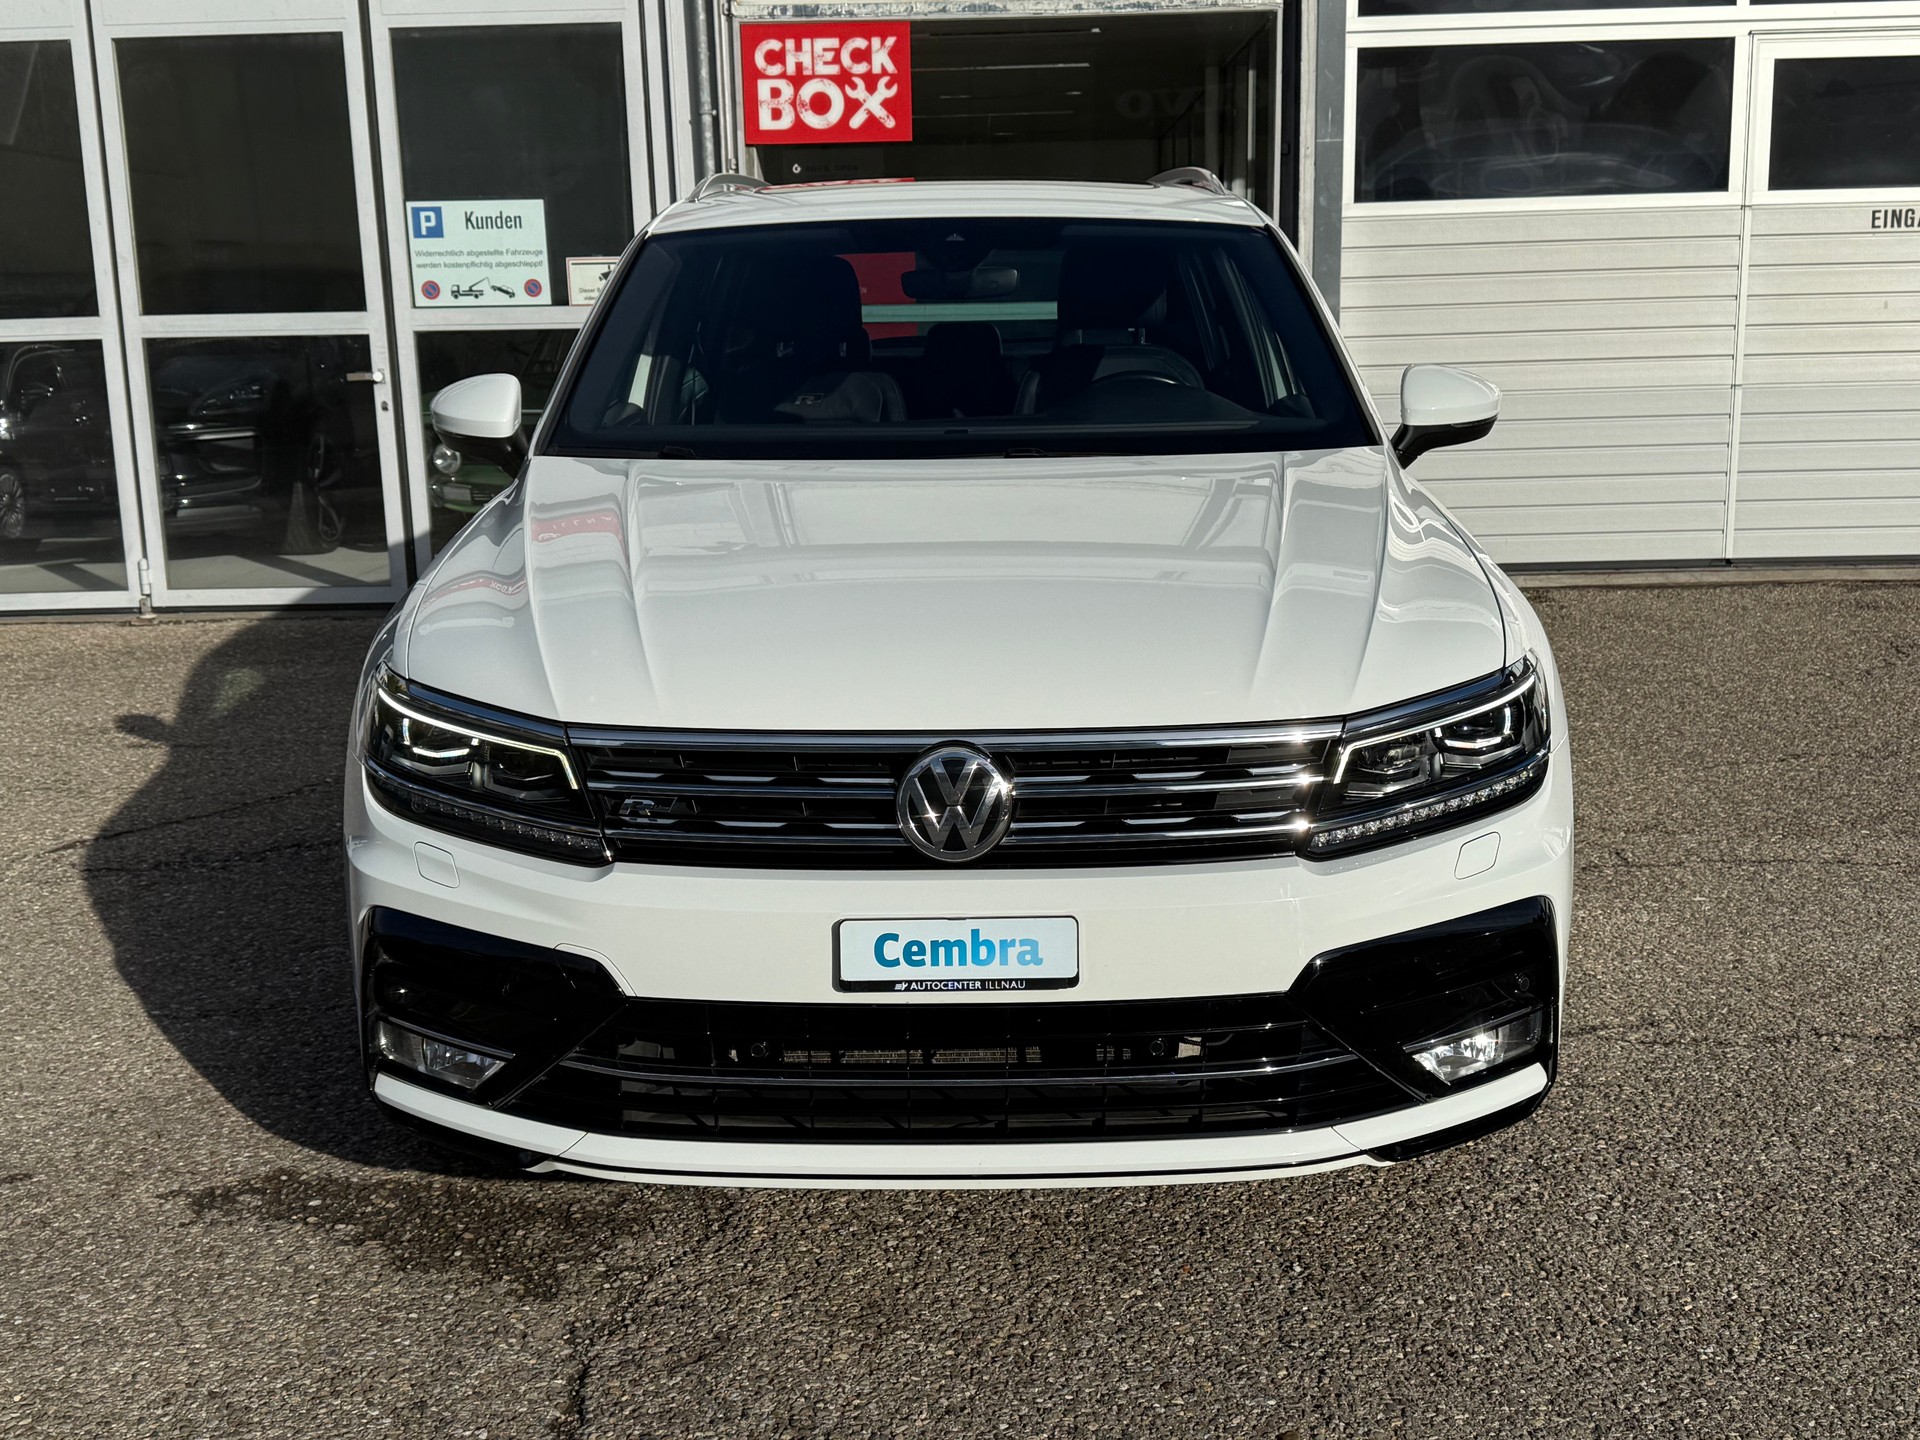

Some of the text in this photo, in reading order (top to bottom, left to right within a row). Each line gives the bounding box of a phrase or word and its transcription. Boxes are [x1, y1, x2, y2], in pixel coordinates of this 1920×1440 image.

[754, 36, 898, 76] CHECK
[757, 76, 898, 131] BOX
[419, 211, 437, 236] P
[464, 210, 523, 230] Kunden
[1871, 208, 1920, 229] EING
[466, 249, 504, 258] abgestellte
[505, 248, 543, 257] Fahrzeuge
[443, 261, 493, 270] kostenpflichtig
[495, 260, 543, 269] abgeschleppt!
[874, 928, 1043, 968] Cembra
[910, 980, 1026, 991] AUTOCENTER ILLNAU
